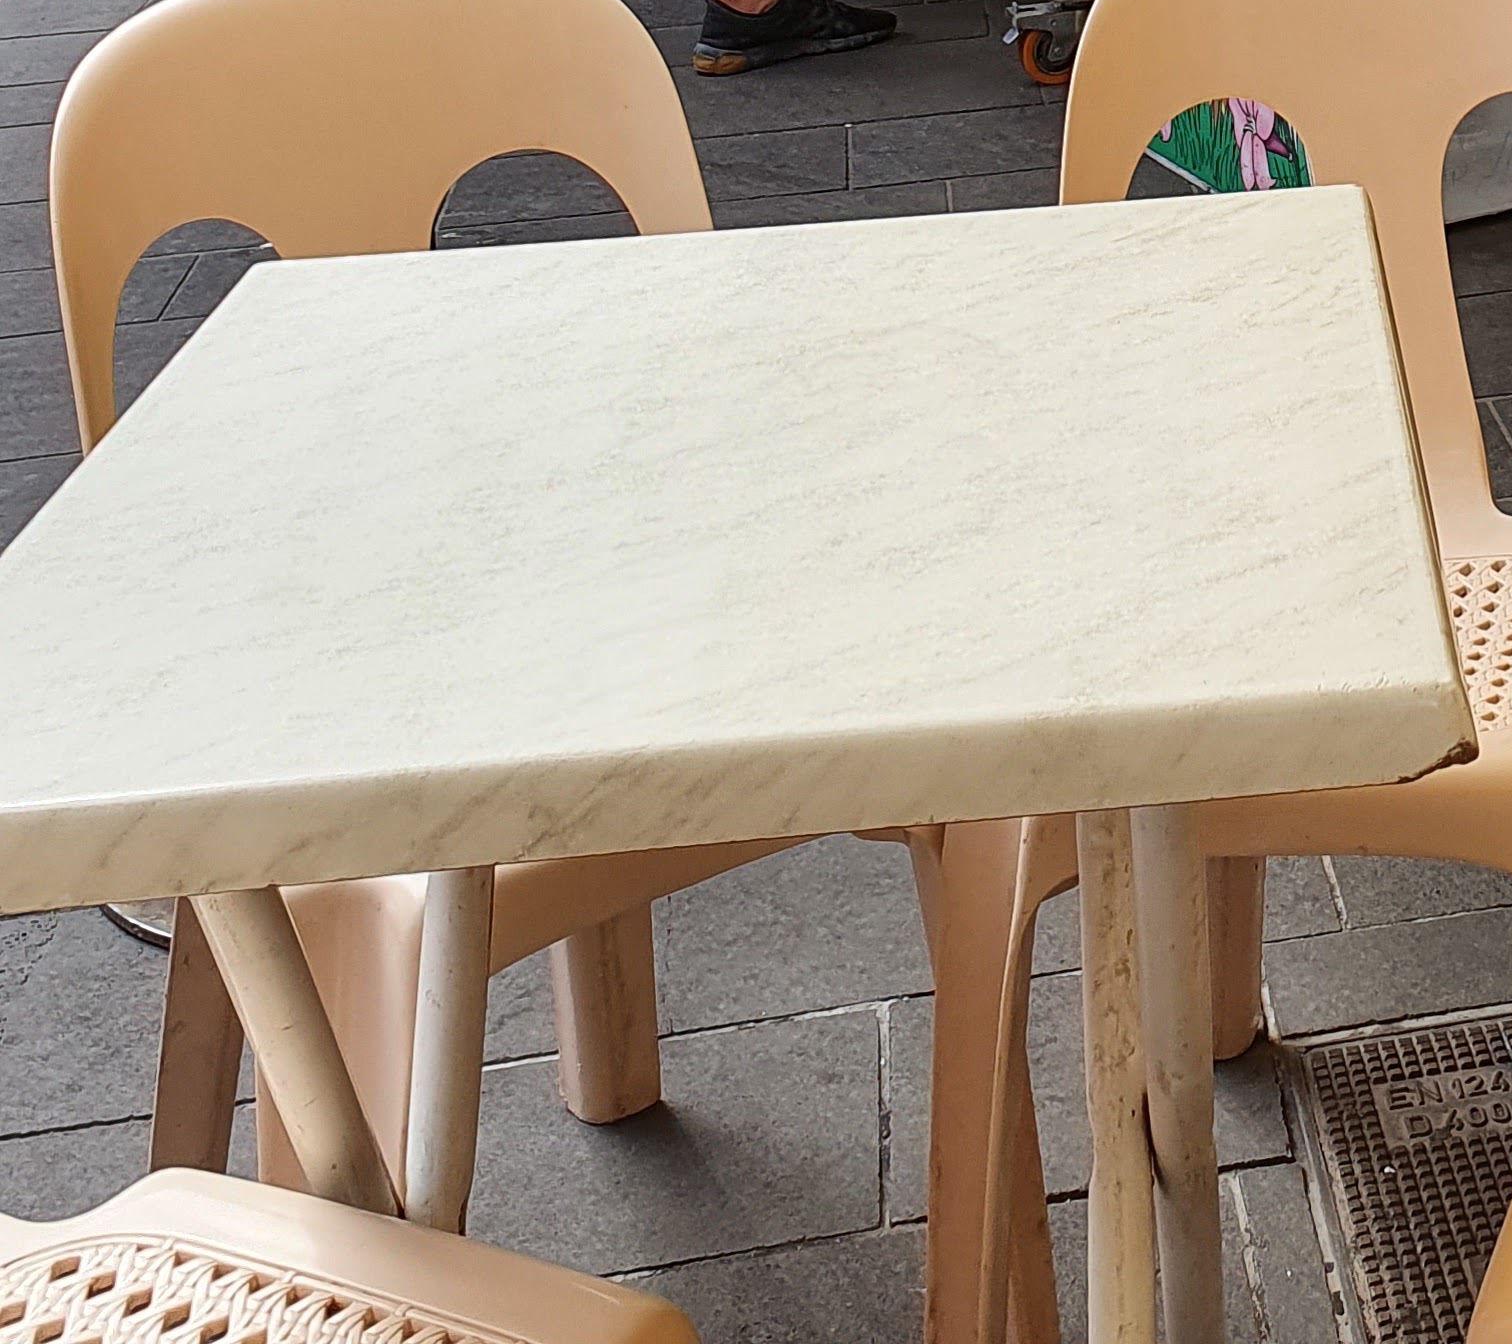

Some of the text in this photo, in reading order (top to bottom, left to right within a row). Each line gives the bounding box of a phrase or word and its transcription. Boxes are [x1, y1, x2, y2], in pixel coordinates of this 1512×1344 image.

[1389, 1071, 1510, 1111] EN 124
[1407, 1103, 1512, 1139] D 400
